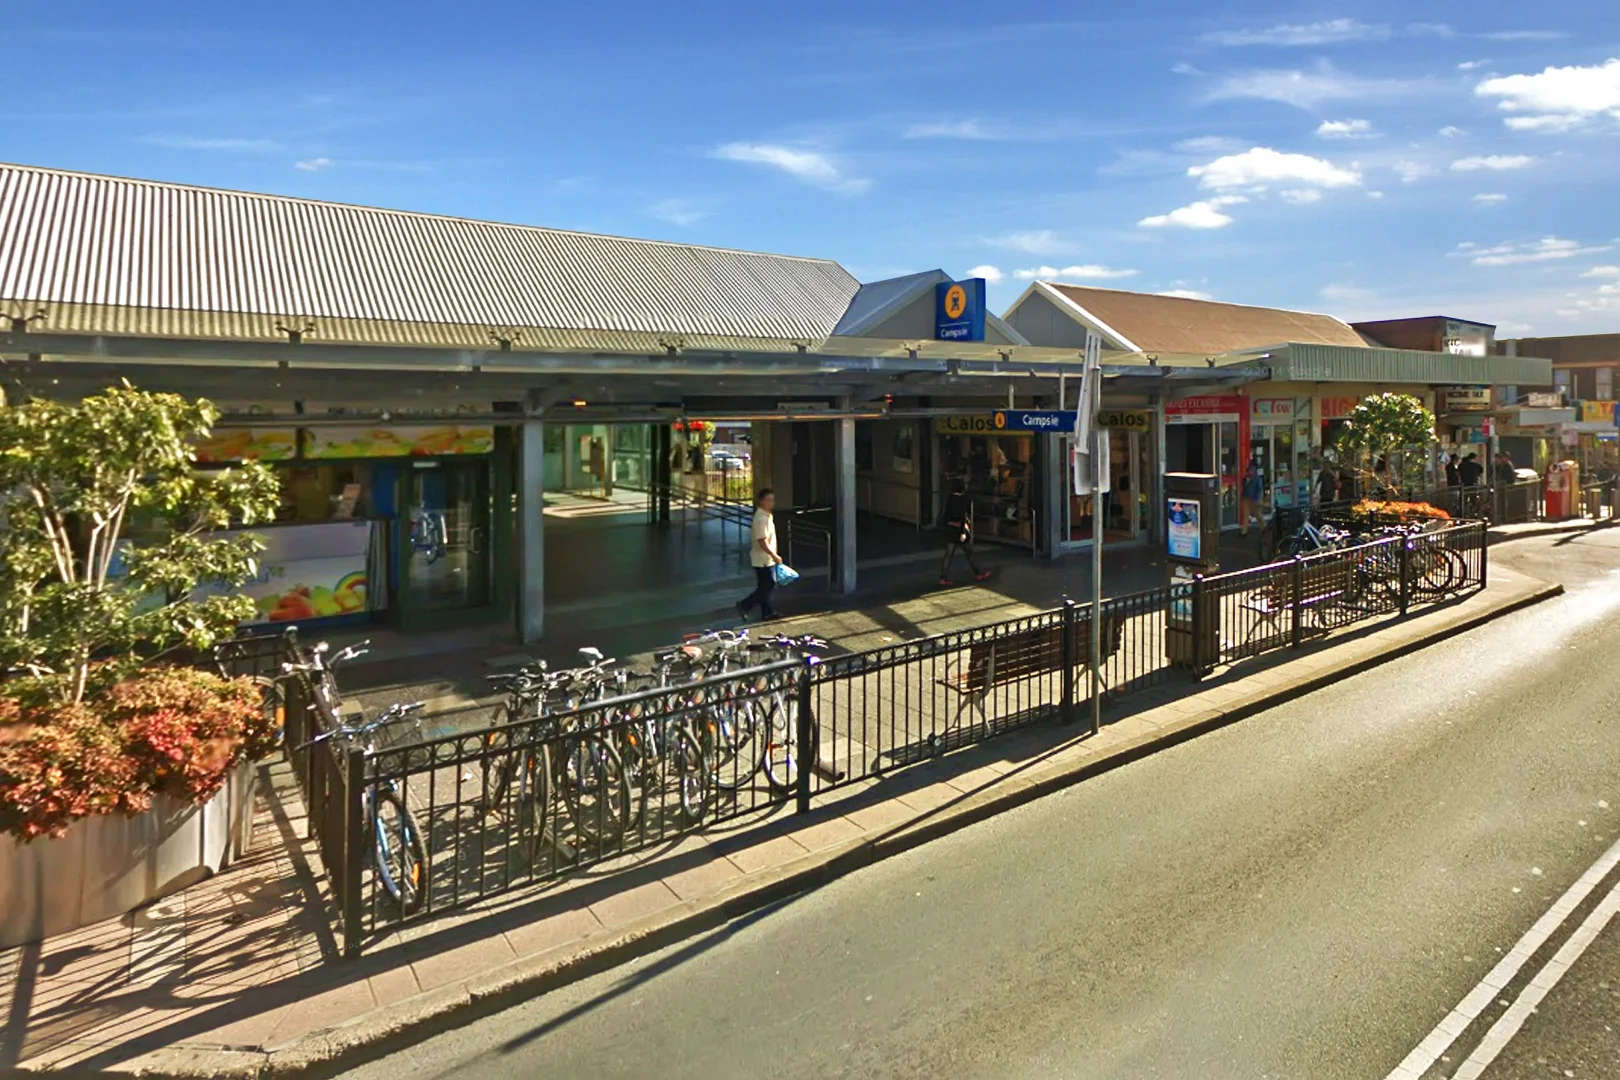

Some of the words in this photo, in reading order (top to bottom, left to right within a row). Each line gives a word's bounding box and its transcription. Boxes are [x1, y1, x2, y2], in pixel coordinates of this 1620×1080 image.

[941, 327, 968, 339] Campsie
[947, 415, 994, 431] Calos
[1022, 414, 1060, 428] Campsie
[1098, 411, 1146, 427] Calos
